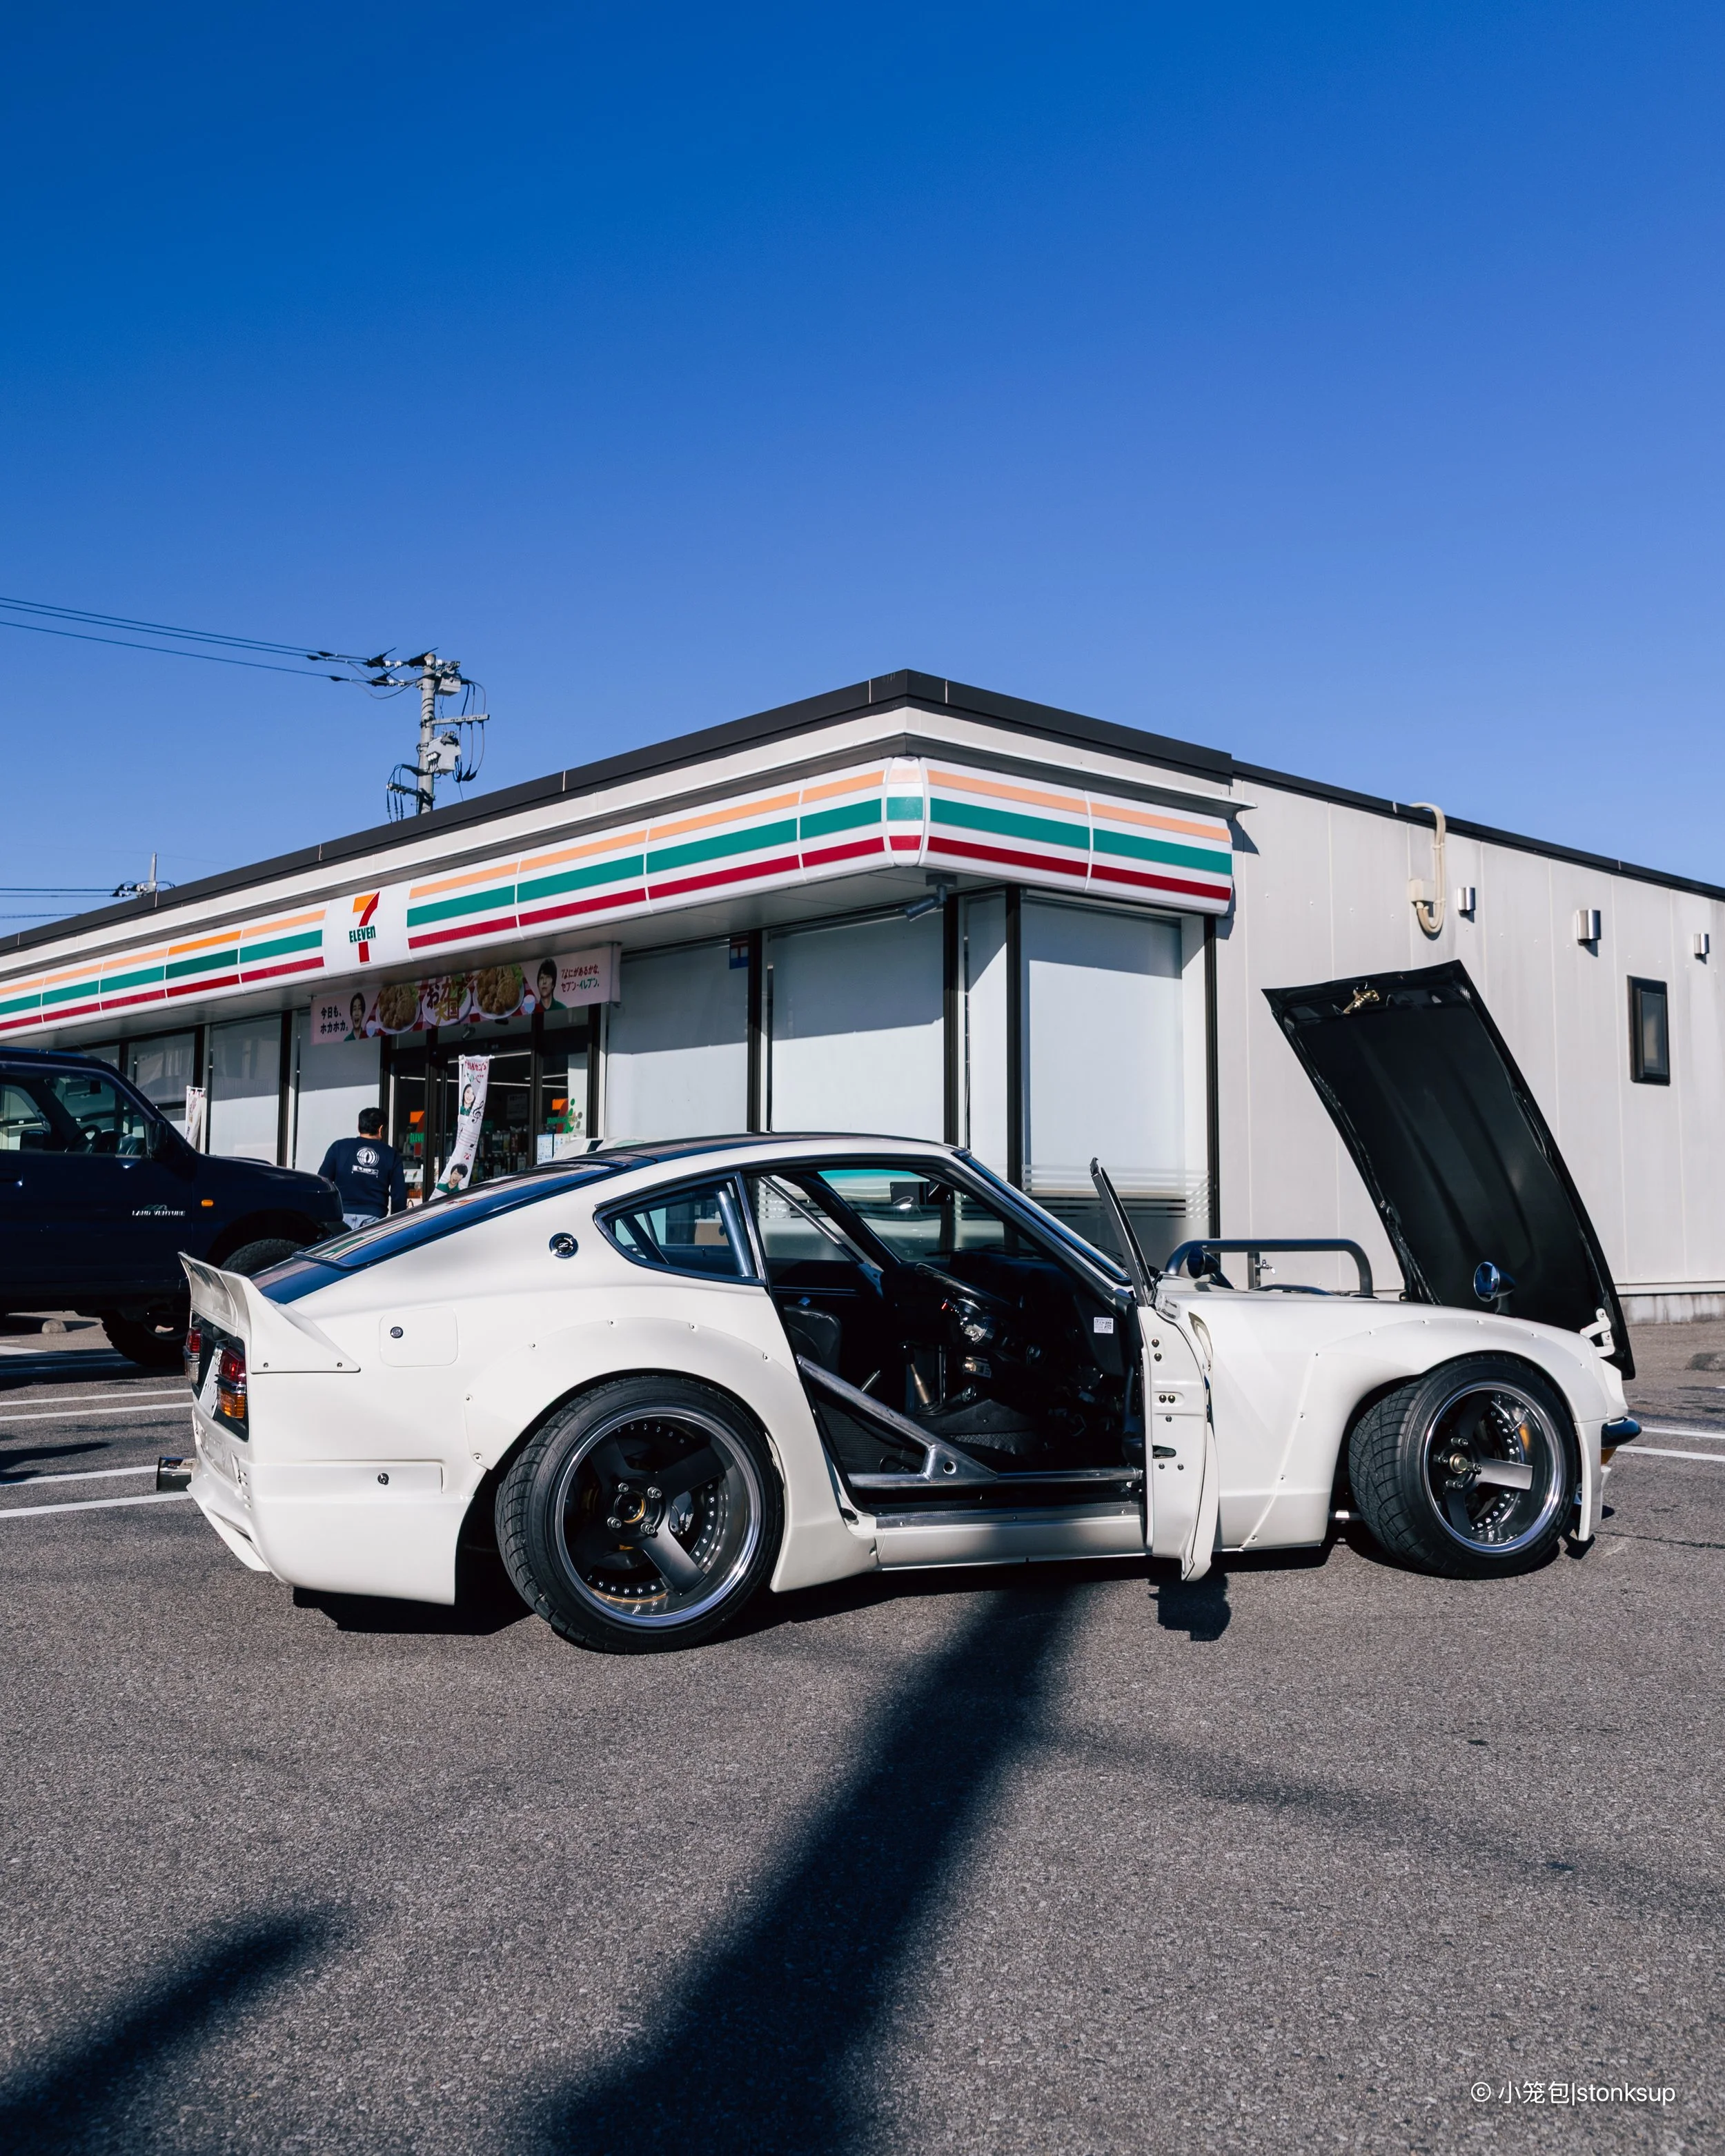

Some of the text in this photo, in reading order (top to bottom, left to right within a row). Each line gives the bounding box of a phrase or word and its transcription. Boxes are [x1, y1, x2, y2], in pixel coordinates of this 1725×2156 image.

[353, 891, 380, 962] 7
[321, 1005, 342, 1018] 今日も、
[320, 1020, 348, 1034] ホカホカ。
